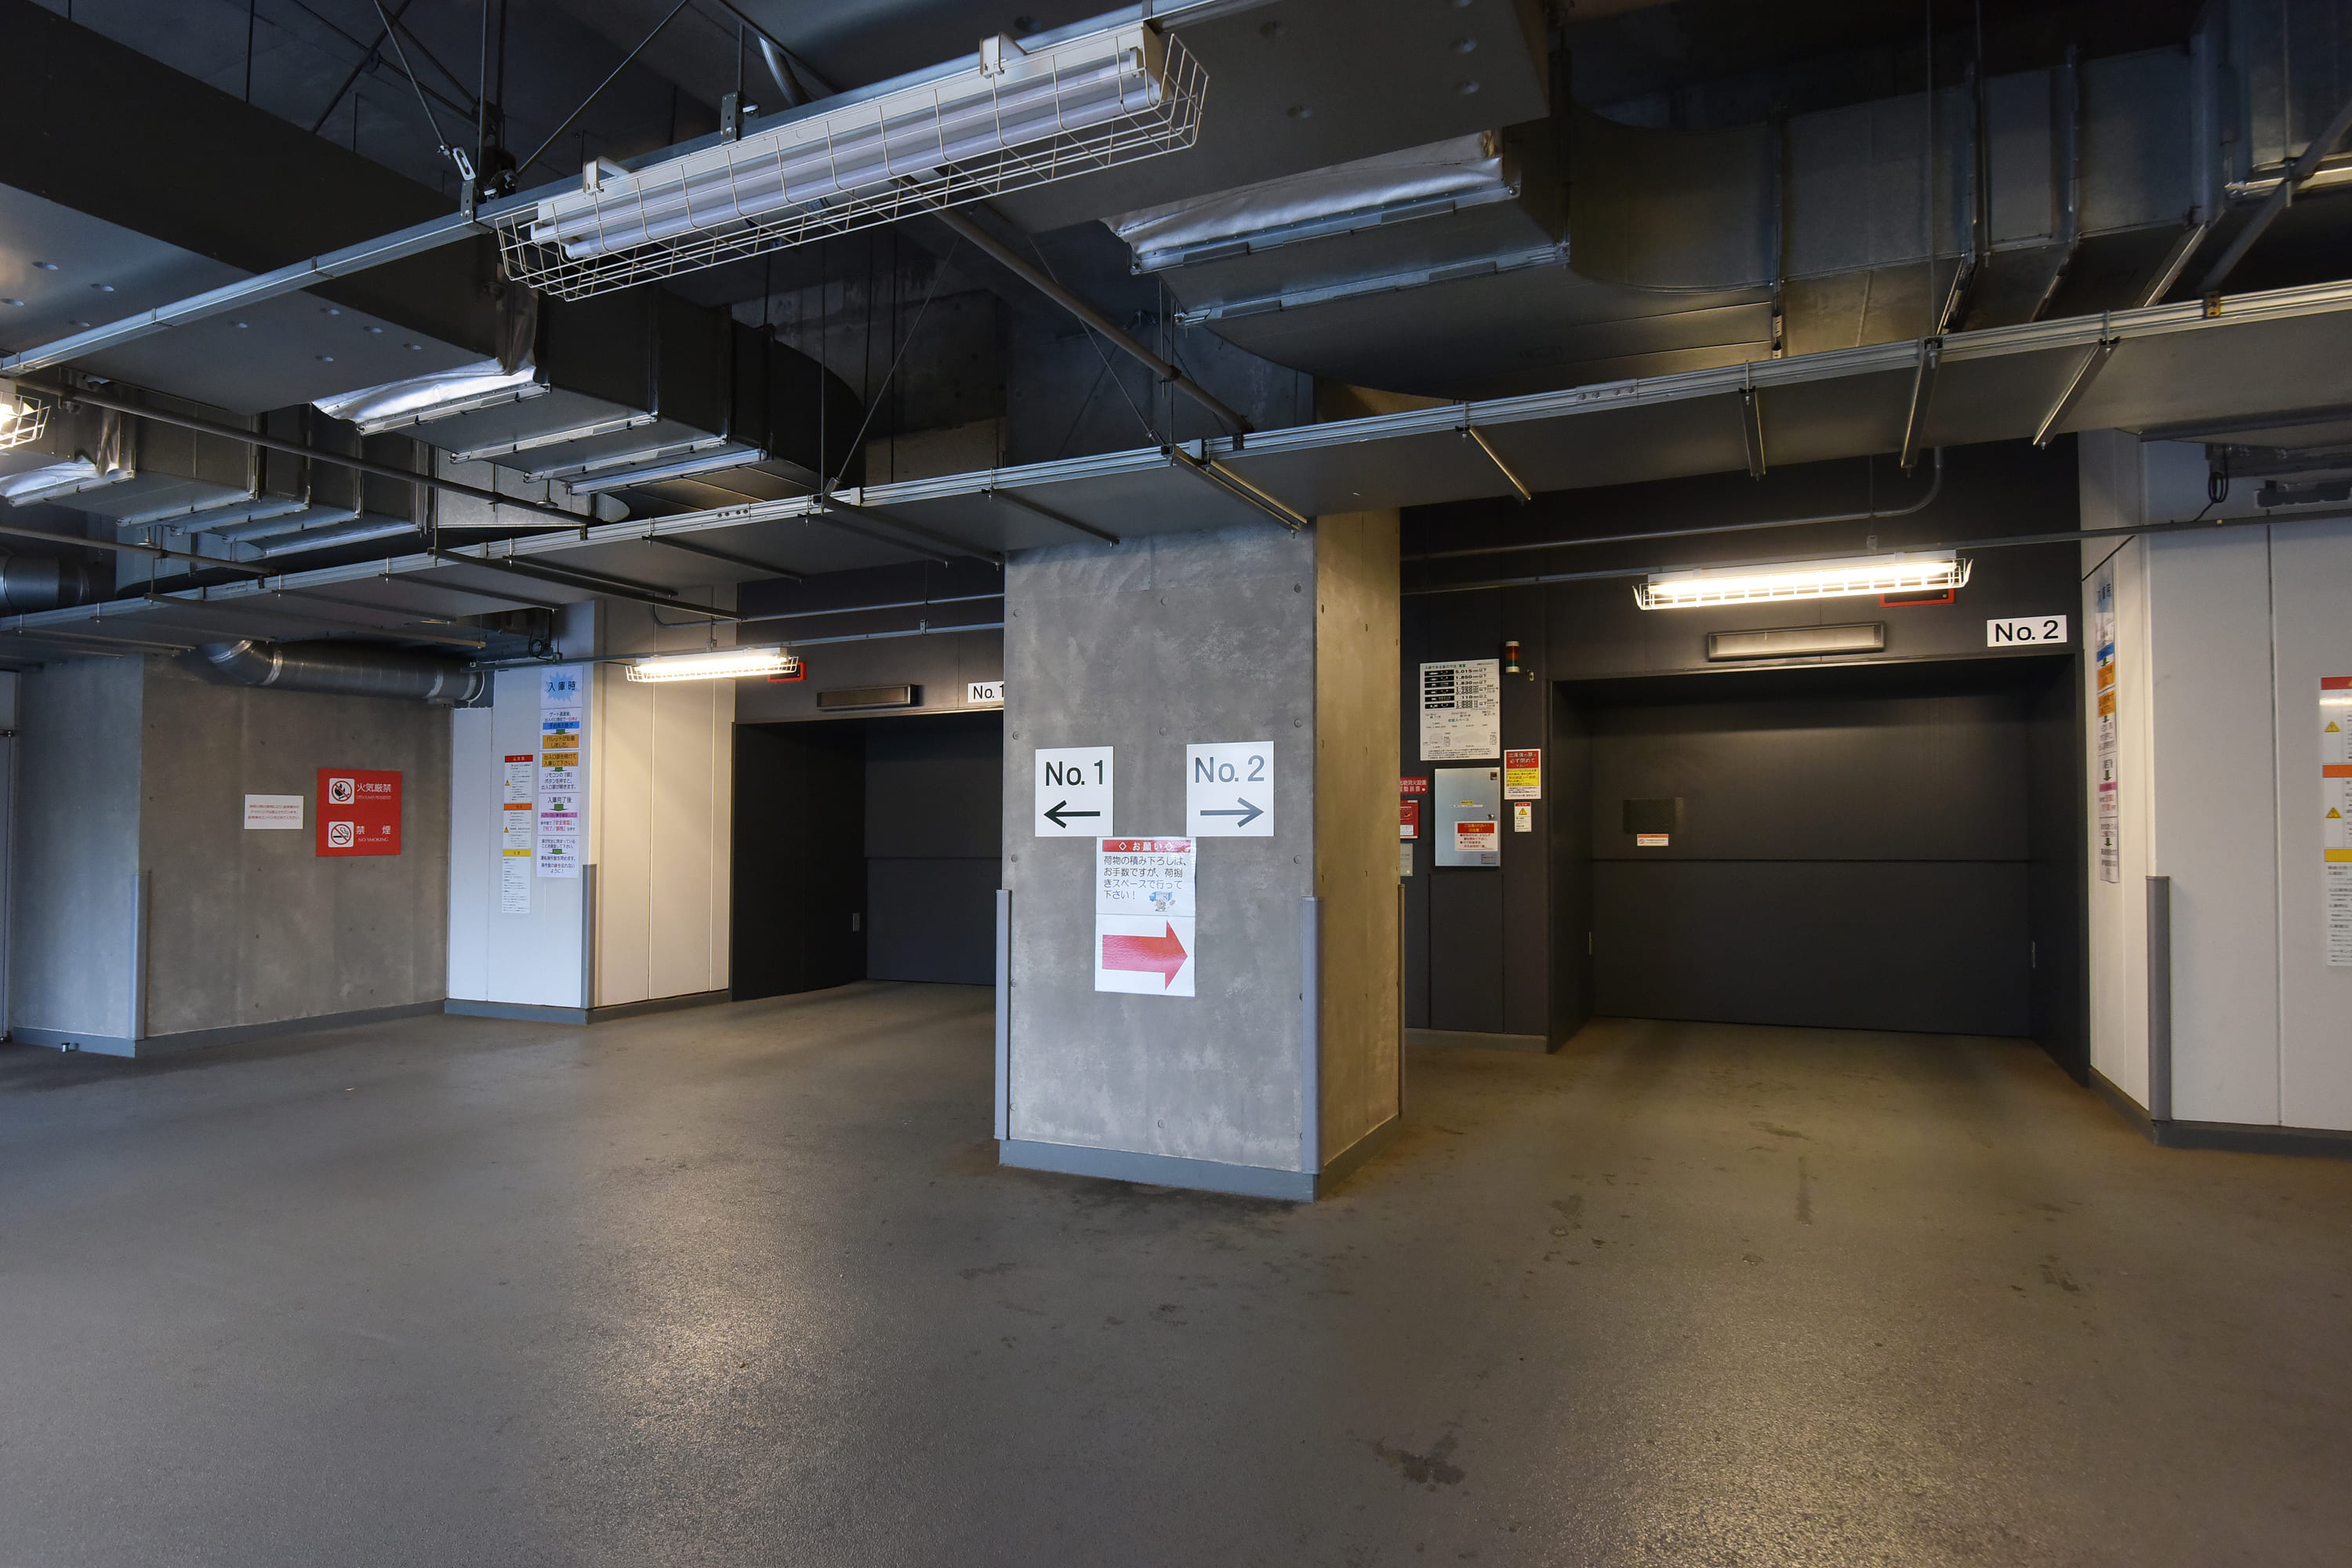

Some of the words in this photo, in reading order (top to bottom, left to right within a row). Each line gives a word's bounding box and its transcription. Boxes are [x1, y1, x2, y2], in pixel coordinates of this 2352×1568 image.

[1995, 622, 2036, 643] No.
[2043, 619, 2060, 640] 2
[548, 681, 576, 691] 入庫時
[973, 686, 995, 699] No.
[999, 684, 1004, 697] 1
[1045, 761, 1086, 786] No.
[1093, 760, 1104, 785] 1
[1195, 757, 1240, 783] No.
[1247, 755, 1265, 782] 2
[356, 782, 392, 793] 火気厳禁
[1132, 842, 1163, 851] お願い
[1103, 855, 1187, 866] 荷物の積み下ろしは、
[1103, 879, 1184, 890] きスペースで行って
